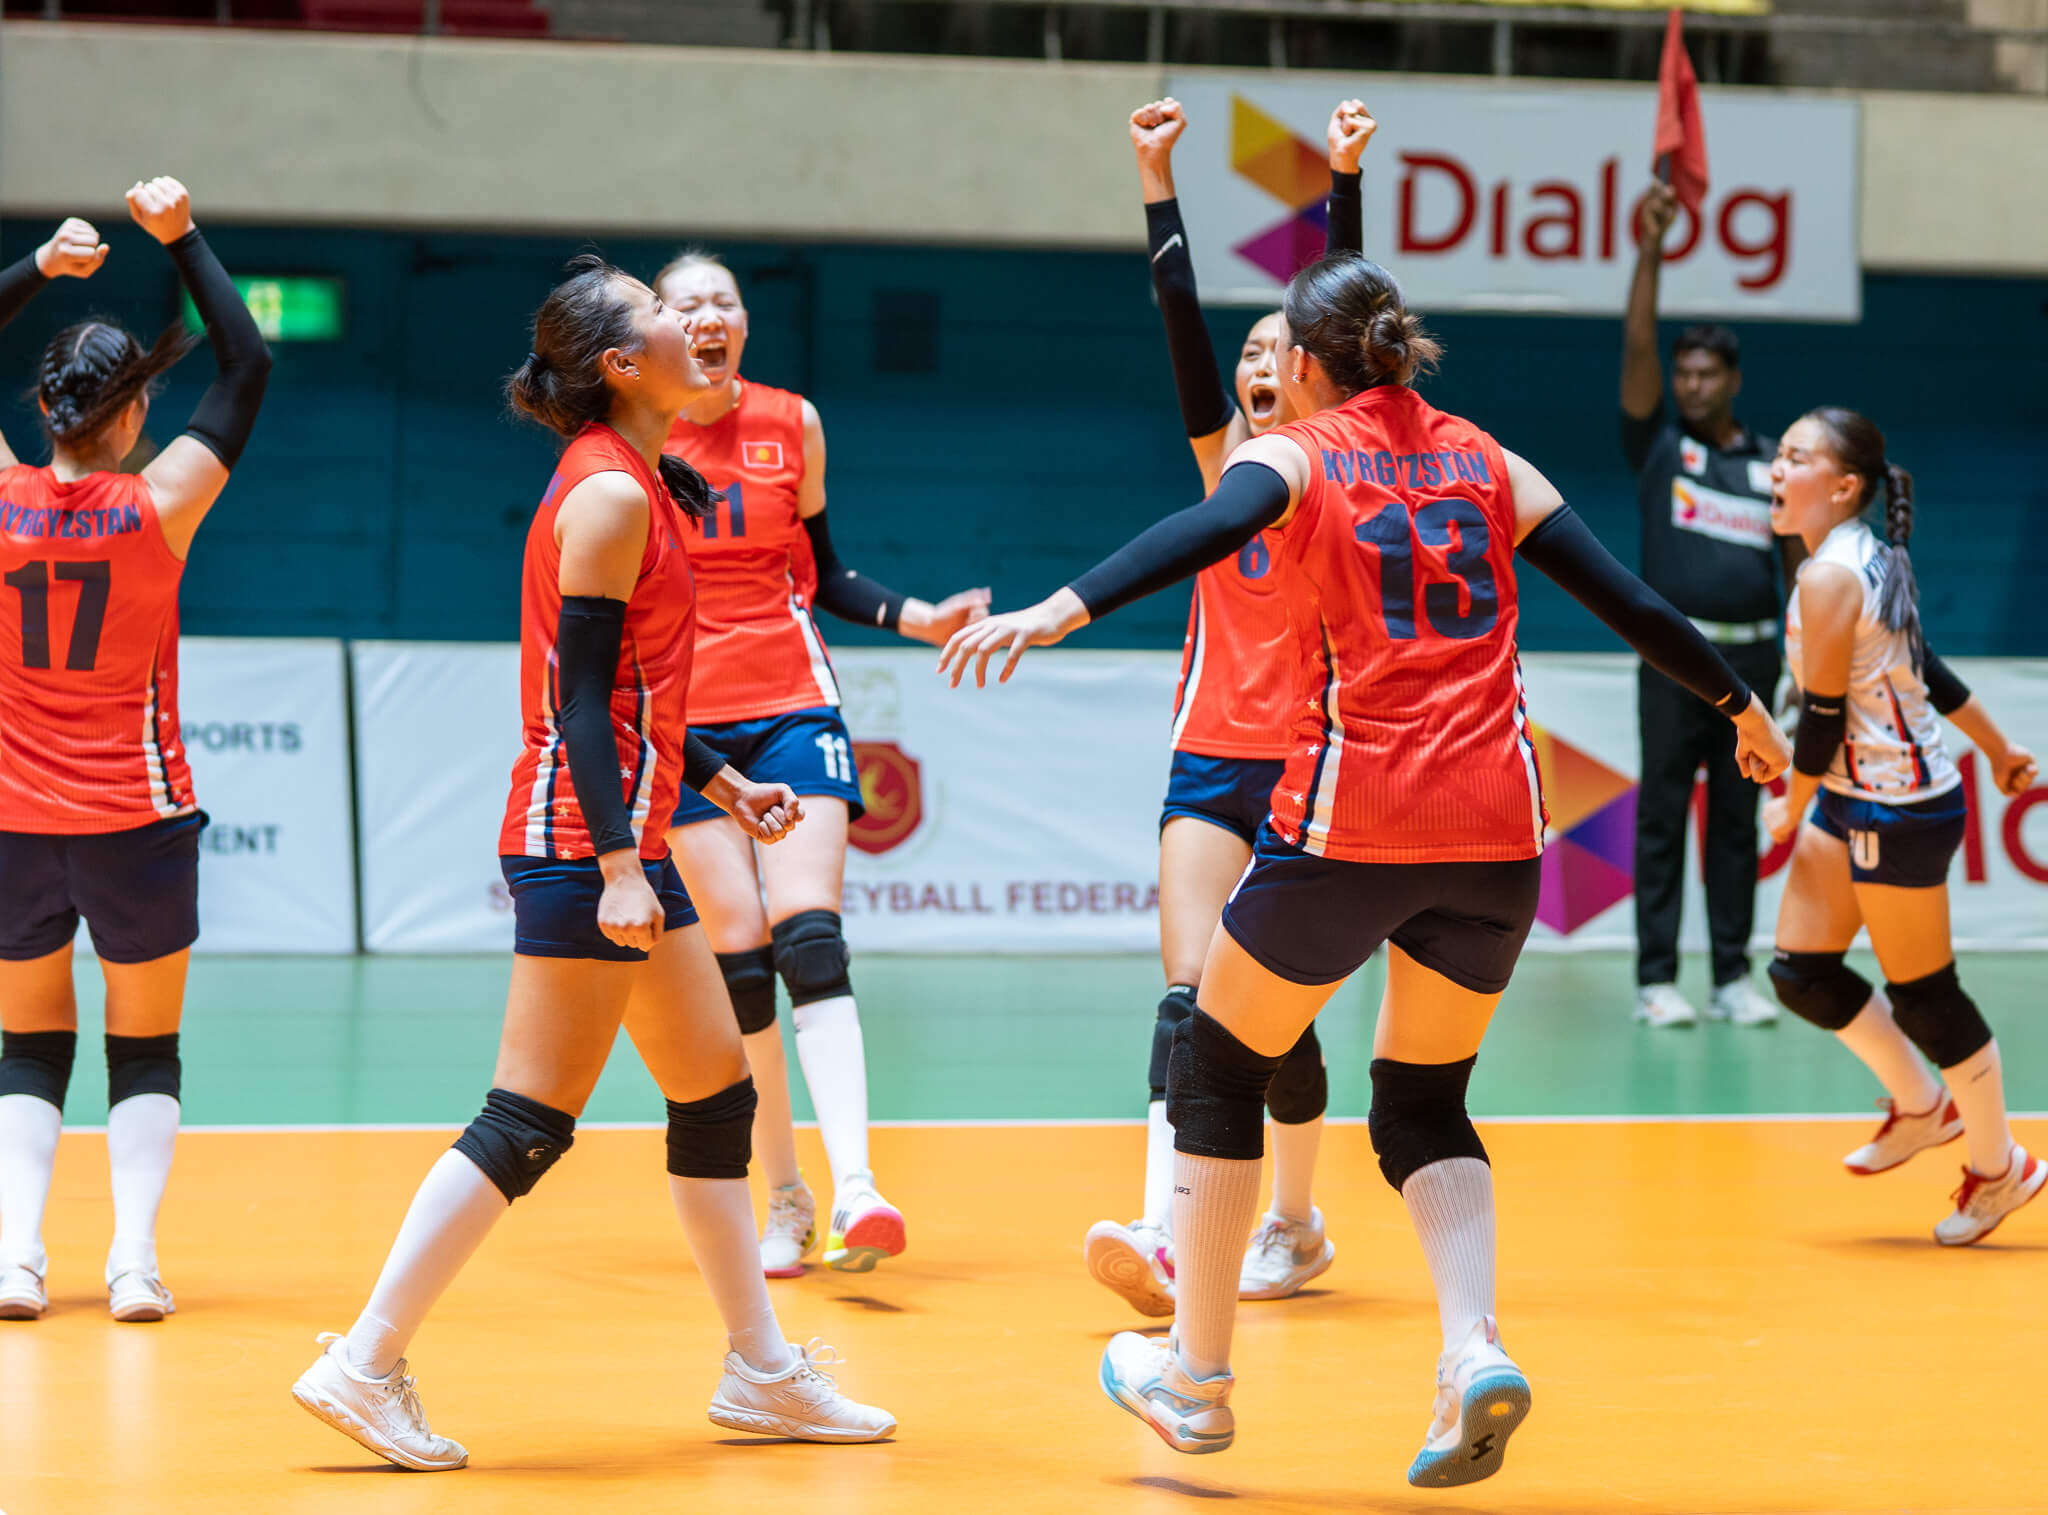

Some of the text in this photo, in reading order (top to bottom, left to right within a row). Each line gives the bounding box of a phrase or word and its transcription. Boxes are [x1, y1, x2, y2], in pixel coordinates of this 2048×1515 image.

[1397, 152, 1792, 291] Dialog
[1354, 499, 1499, 639] 13
[4, 560, 110, 671] 17
[181, 722, 303, 754] PORTS
[815, 733, 851, 782] 11
[201, 824, 281, 854] ENT
[841, 881, 1159, 913] EYBALL FEDERA
